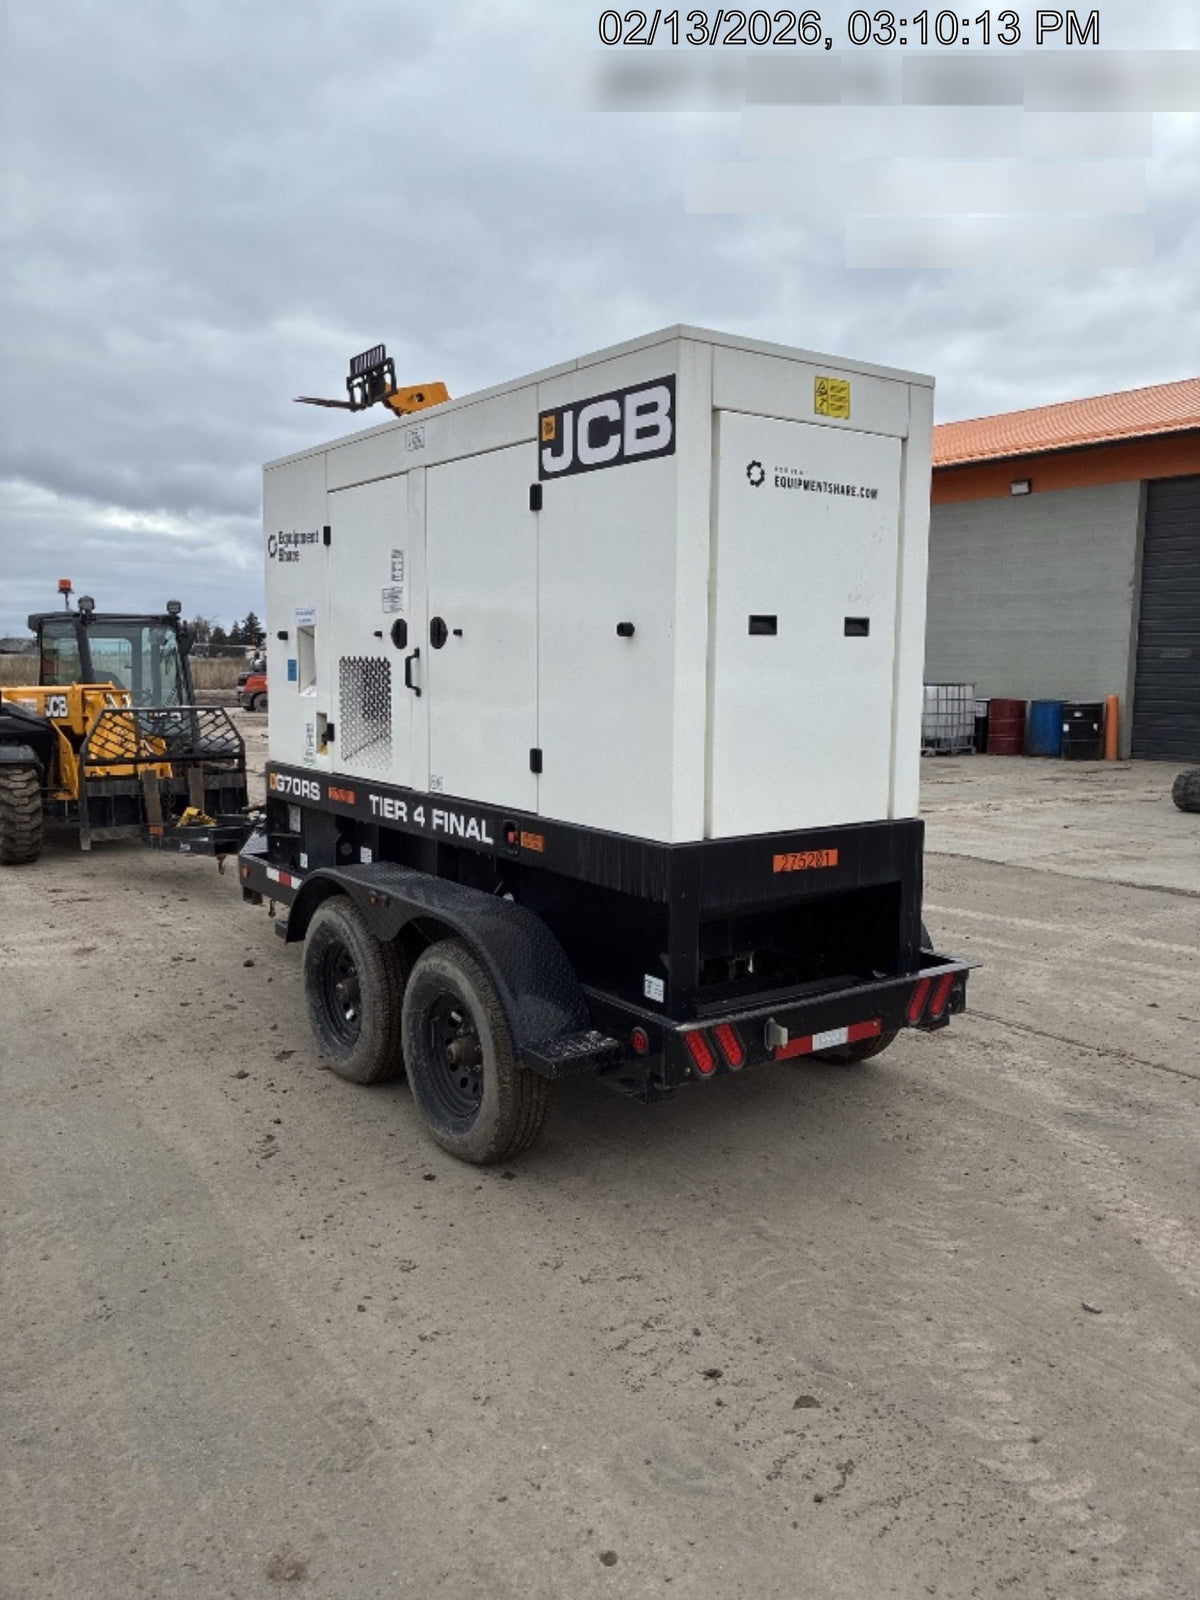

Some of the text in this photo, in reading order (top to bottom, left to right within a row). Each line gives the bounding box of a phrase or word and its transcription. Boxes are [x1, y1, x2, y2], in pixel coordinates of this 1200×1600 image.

[542, 385, 673, 473] JCB
[774, 475, 878, 499] EQUIPMENTSHARE.COM
[45, 696, 68, 717] JCB
[368, 794, 408, 823] TIER
[413, 806, 426, 828] 4
[432, 808, 494, 845] FINAL
